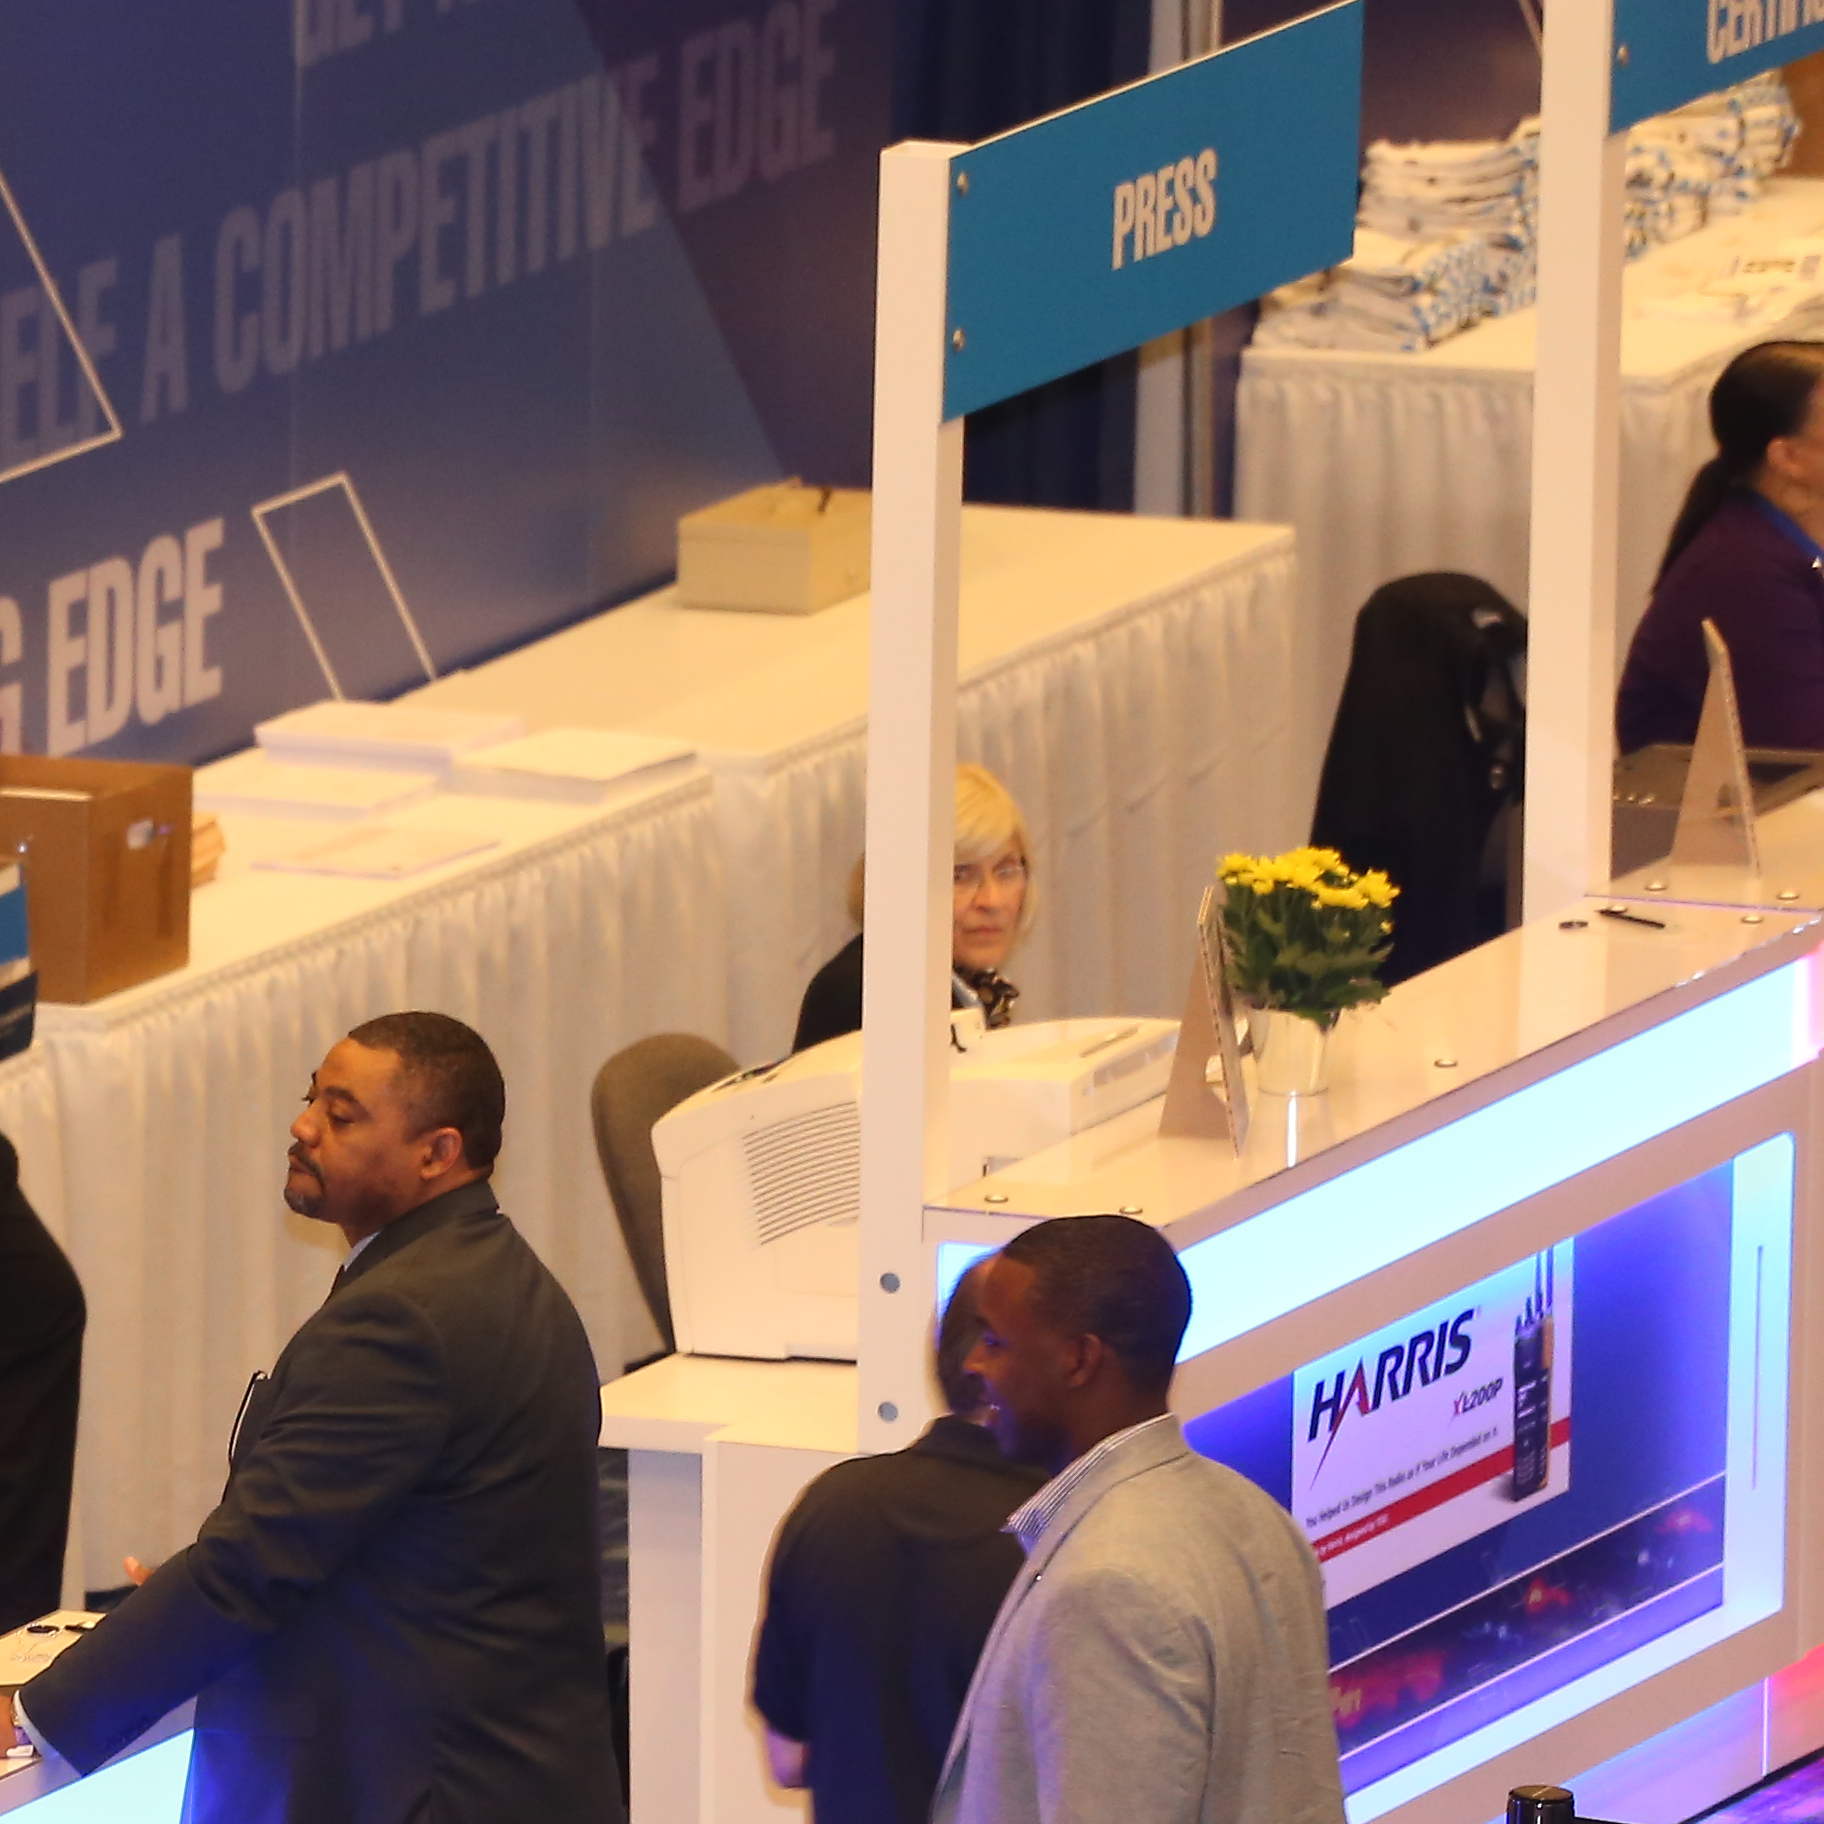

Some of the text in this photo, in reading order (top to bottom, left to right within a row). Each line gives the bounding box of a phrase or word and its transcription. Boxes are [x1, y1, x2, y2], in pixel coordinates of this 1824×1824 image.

[143, 235, 188, 423] A
[215, 53, 659, 393] COMPETITIVE
[678, 0, 836, 211] EDGE
[1112, 148, 1217, 271] PRESS
[48, 517, 225, 758] EDGE
[1308, 1308, 1477, 1490] HARRIS
